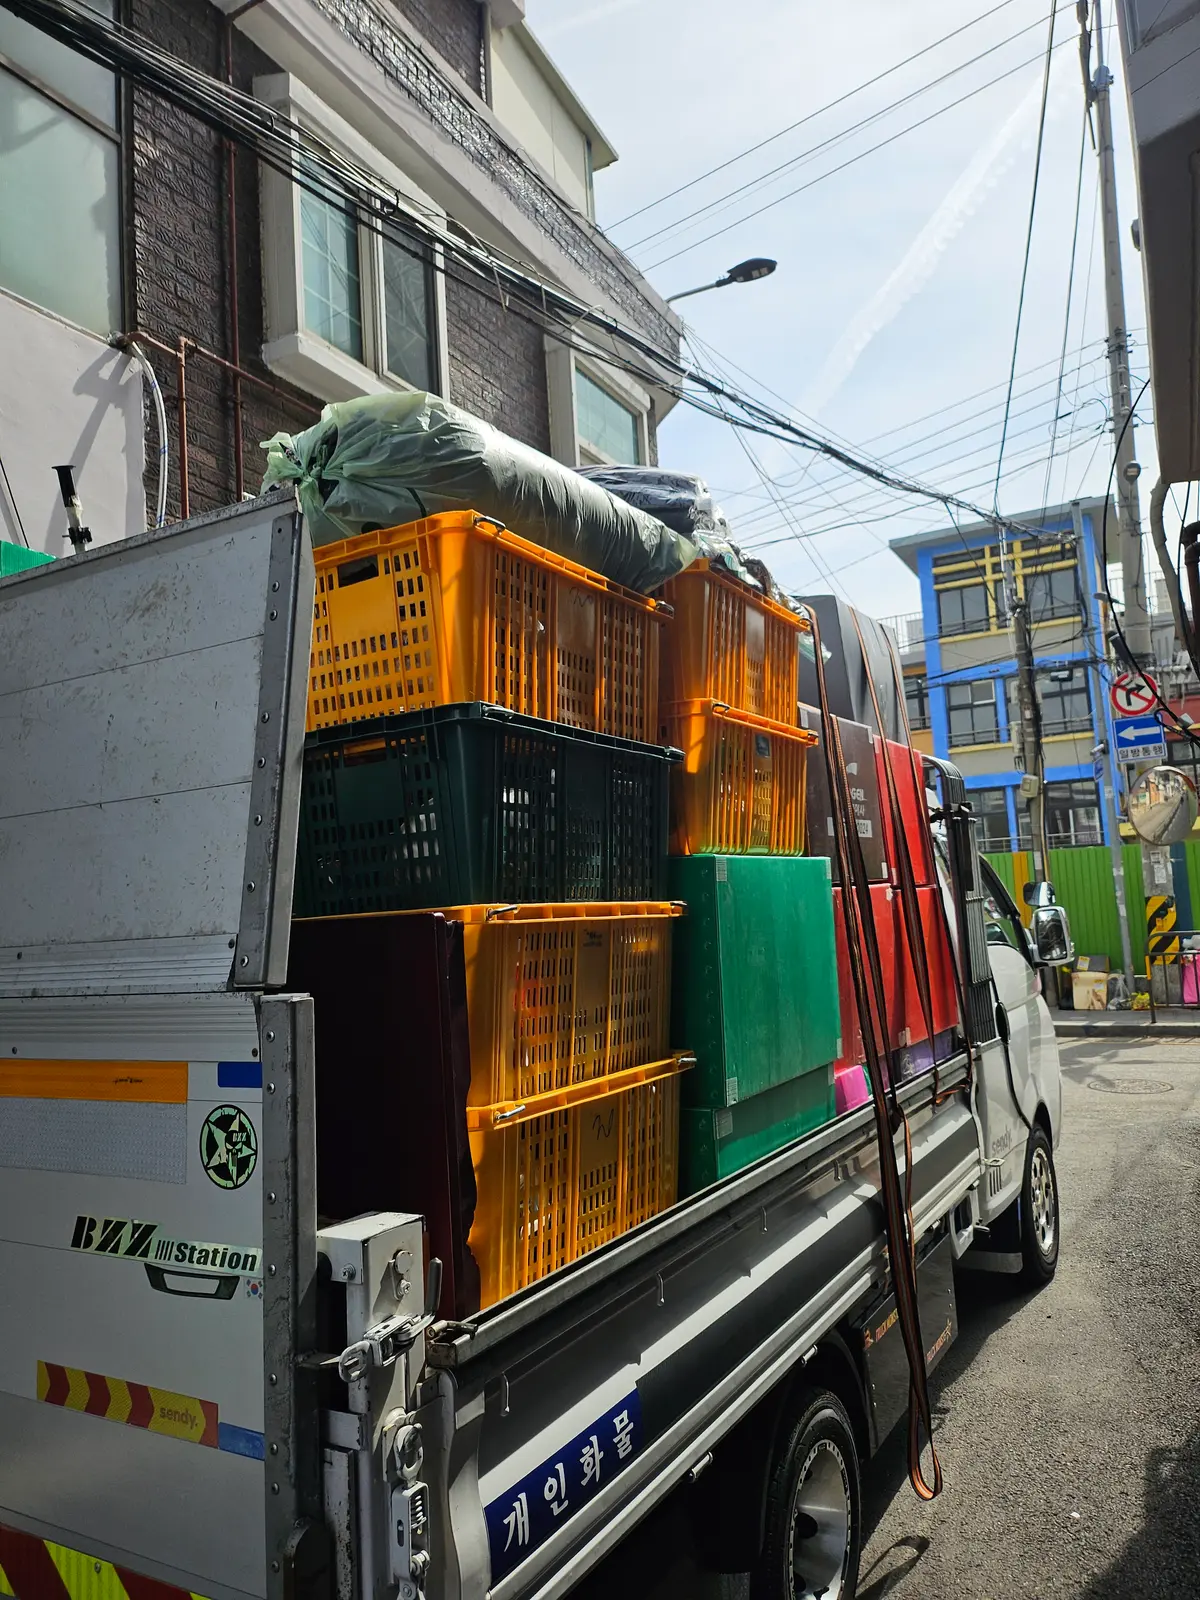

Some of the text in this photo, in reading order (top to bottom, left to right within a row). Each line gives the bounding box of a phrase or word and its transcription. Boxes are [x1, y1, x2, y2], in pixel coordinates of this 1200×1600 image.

[1119, 745, 1163, 759] 일방통행
[174, 1242, 258, 1272] Station
[160, 1407, 198, 1430] sendy.
